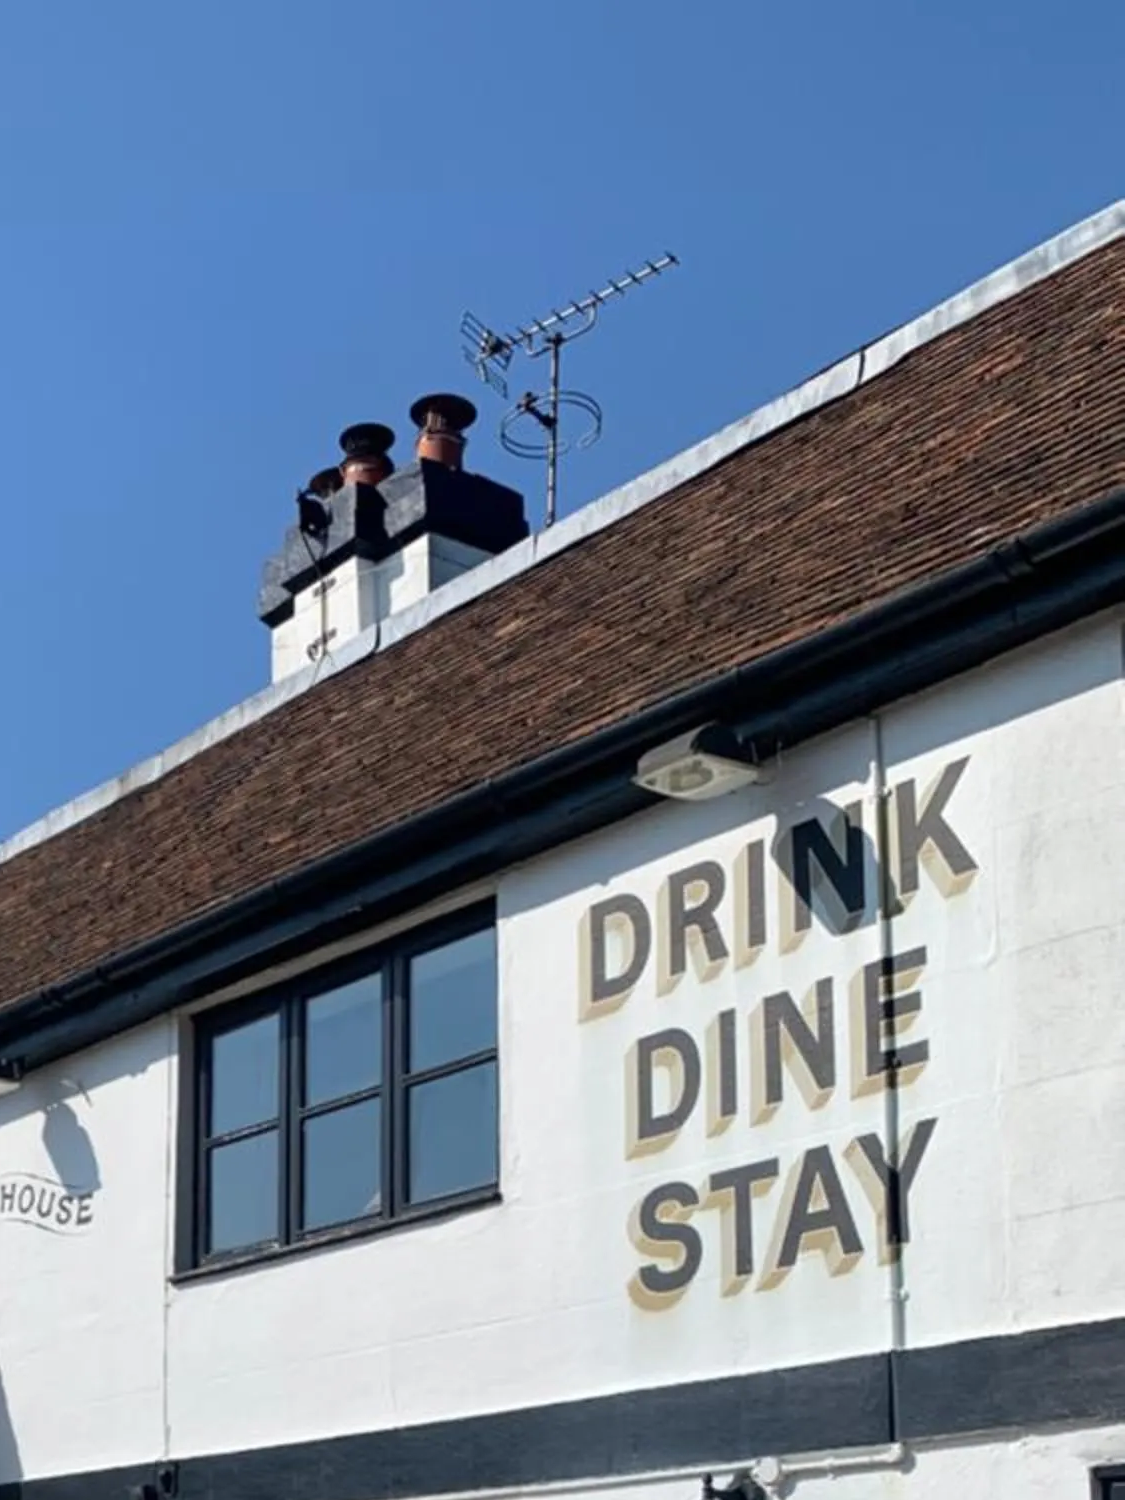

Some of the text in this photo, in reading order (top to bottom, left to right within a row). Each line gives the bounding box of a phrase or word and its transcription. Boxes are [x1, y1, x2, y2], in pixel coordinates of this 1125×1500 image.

[579, 755, 978, 1021] DRINK
[625, 946, 929, 1160] DINE
[0, 1182, 93, 1225] HOUSE
[628, 1117, 937, 1310] STAY
